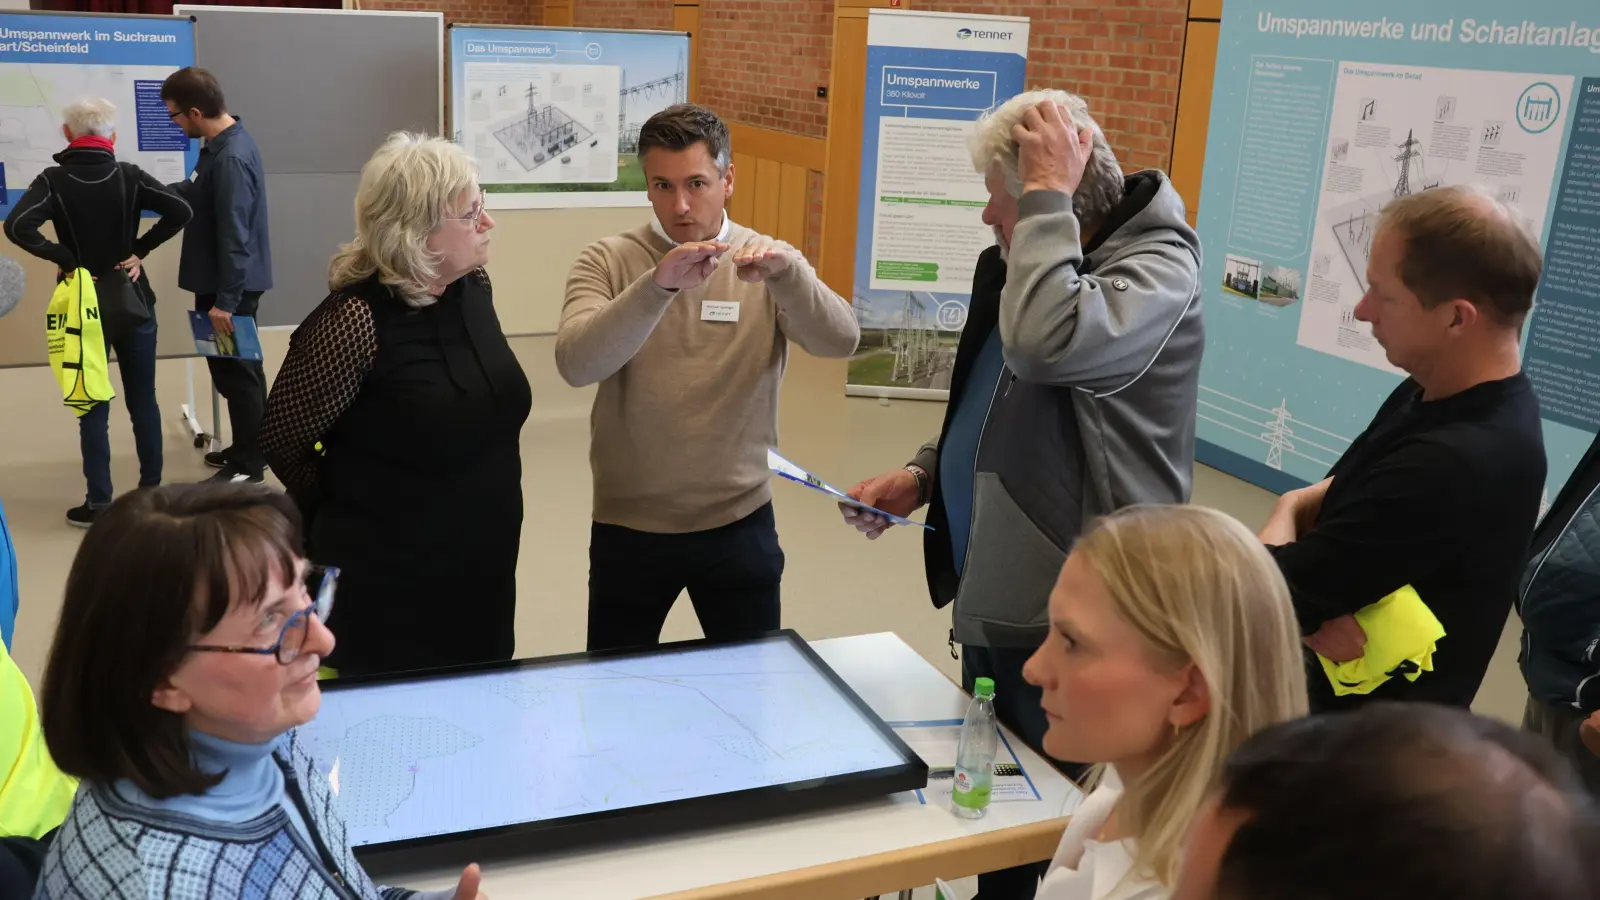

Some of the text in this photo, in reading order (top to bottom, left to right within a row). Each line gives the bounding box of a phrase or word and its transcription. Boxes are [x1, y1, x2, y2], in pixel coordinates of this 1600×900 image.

[1257, 11, 1404, 40] Umspannwerke
[1411, 19, 1452, 42] und
[0, 27, 176, 43] Umspannwerk im Suchraum
[0, 41, 89, 54] art/Scheinfeld
[467, 43, 552, 55] Das Umspannwerk
[1343, 67, 1354, 75] Das
[1355, 68, 1395, 79] Umspannwerk
[887, 73, 980, 90] Umspannwerke
[886, 89, 926, 99] 380 Kilovolt
